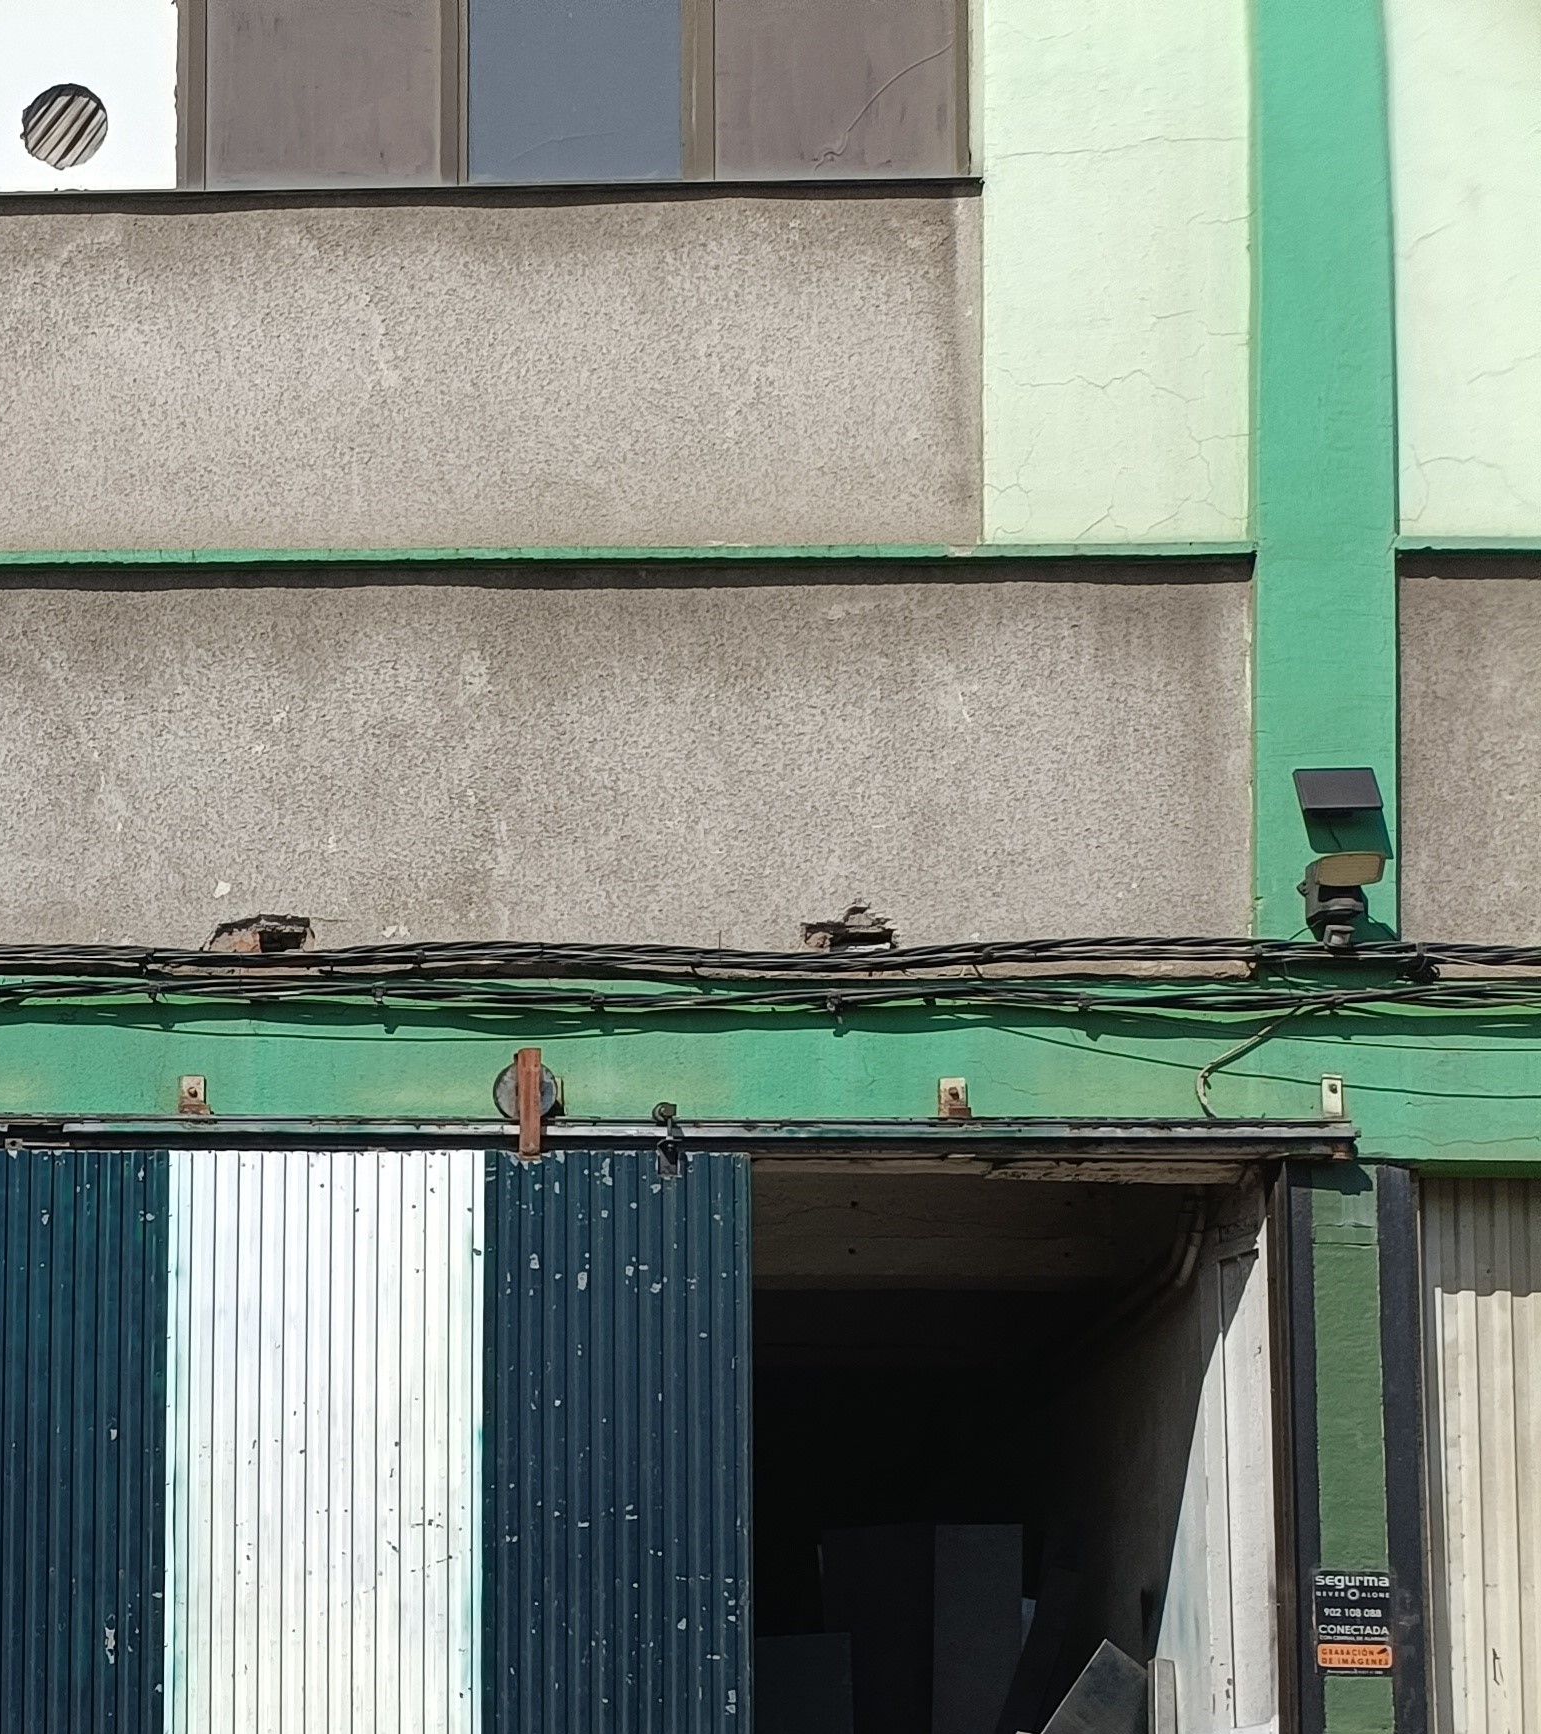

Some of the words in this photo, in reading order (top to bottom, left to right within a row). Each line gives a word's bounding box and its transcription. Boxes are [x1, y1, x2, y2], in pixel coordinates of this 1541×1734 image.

[1315, 1575, 1391, 1589] segurma
[1315, 1590, 1345, 1598] NEVER
[1323, 1607, 1342, 1617] 902
[1318, 1624, 1390, 1636] CONECTADA
[1321, 1647, 1375, 1656] GRABACIÓN
[1321, 1657, 1333, 1665] DE
